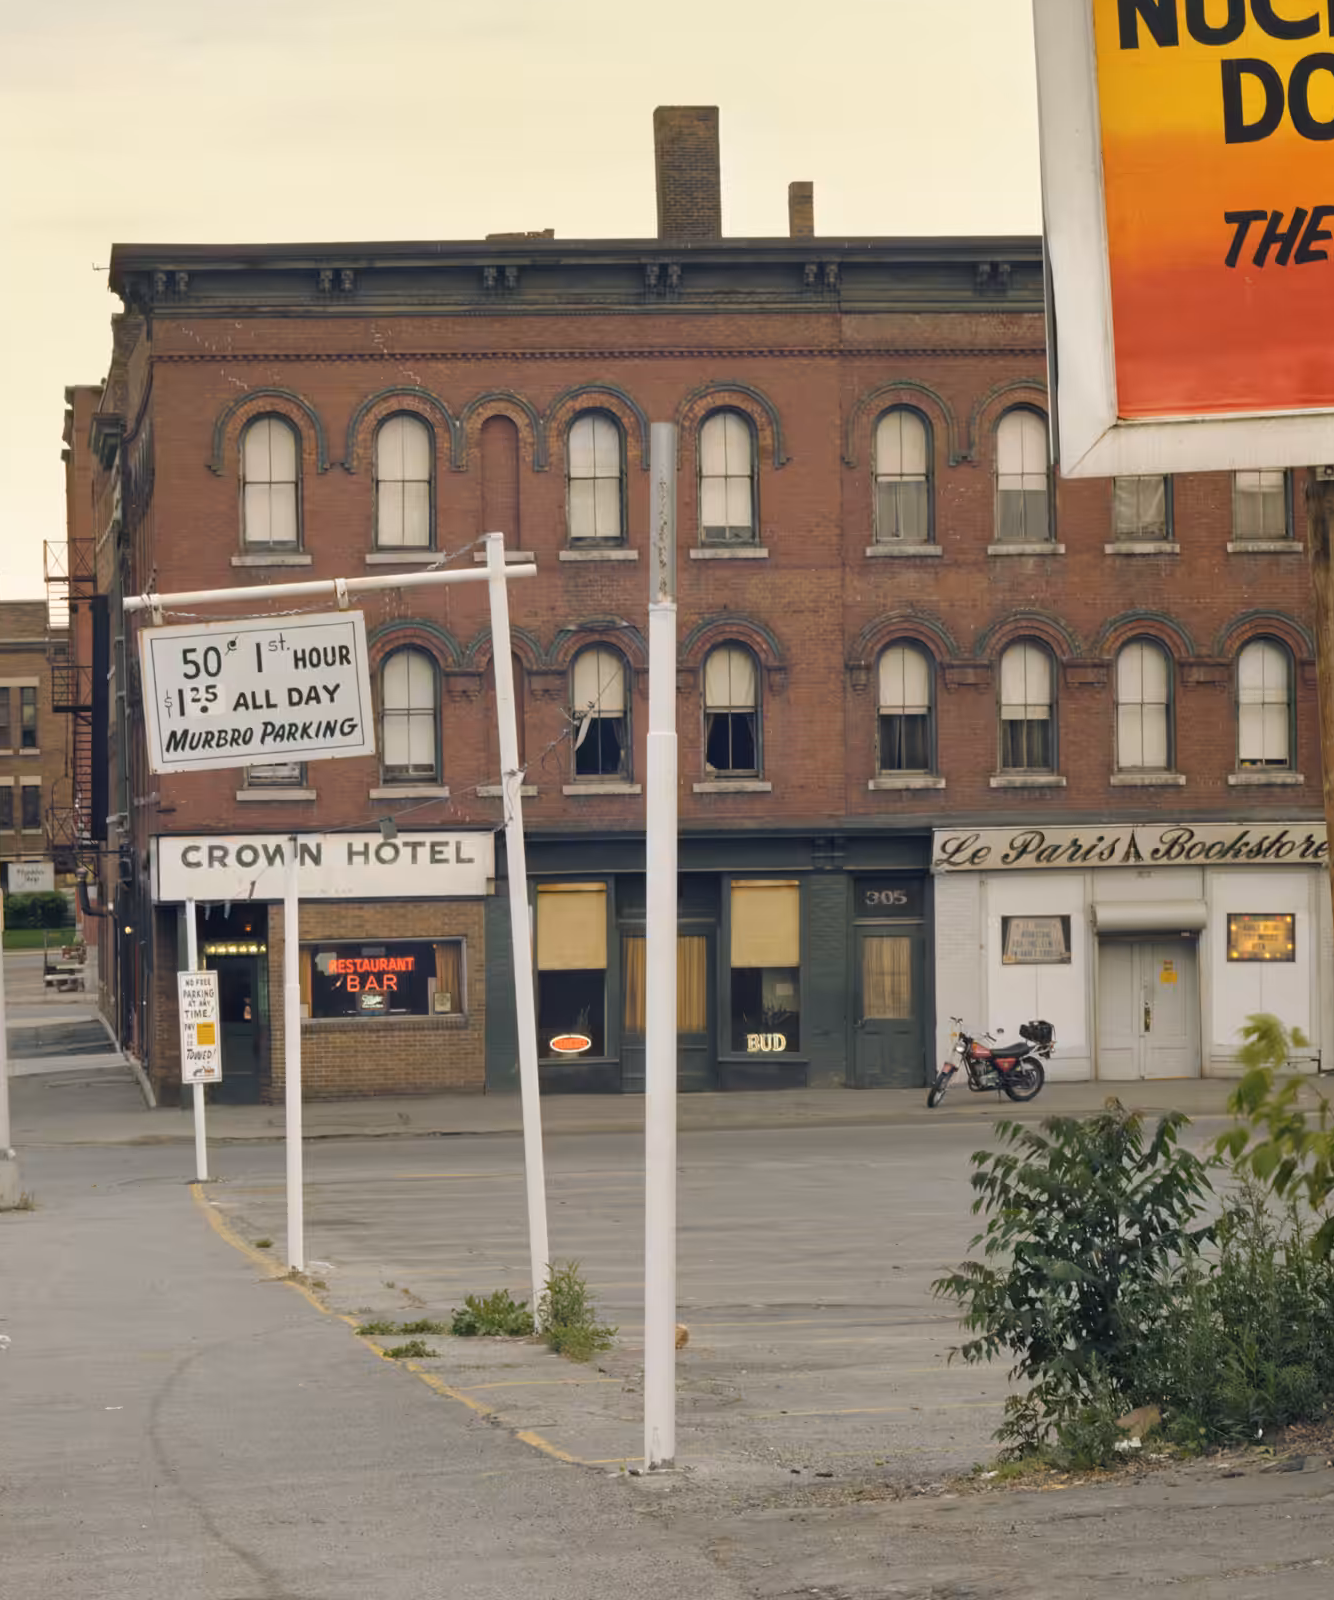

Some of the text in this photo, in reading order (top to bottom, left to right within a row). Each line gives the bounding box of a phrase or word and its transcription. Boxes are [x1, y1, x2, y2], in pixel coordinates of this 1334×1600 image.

[294, 645, 351, 669] HOUR
[233, 689, 278, 711] ALL
[287, 684, 340, 706] DAY
[165, 718, 358, 753] MURBRO PARKING
[181, 840, 475, 868] CROWN HOTEL
[934, 828, 1329, 866] Le Paris Bookstore
[865, 889, 907, 904] 305
[328, 957, 414, 974] RESTAURANT
[183, 989, 214, 998] PARKING
[347, 974, 397, 992] BAR
[747, 1033, 786, 1052] BUD
